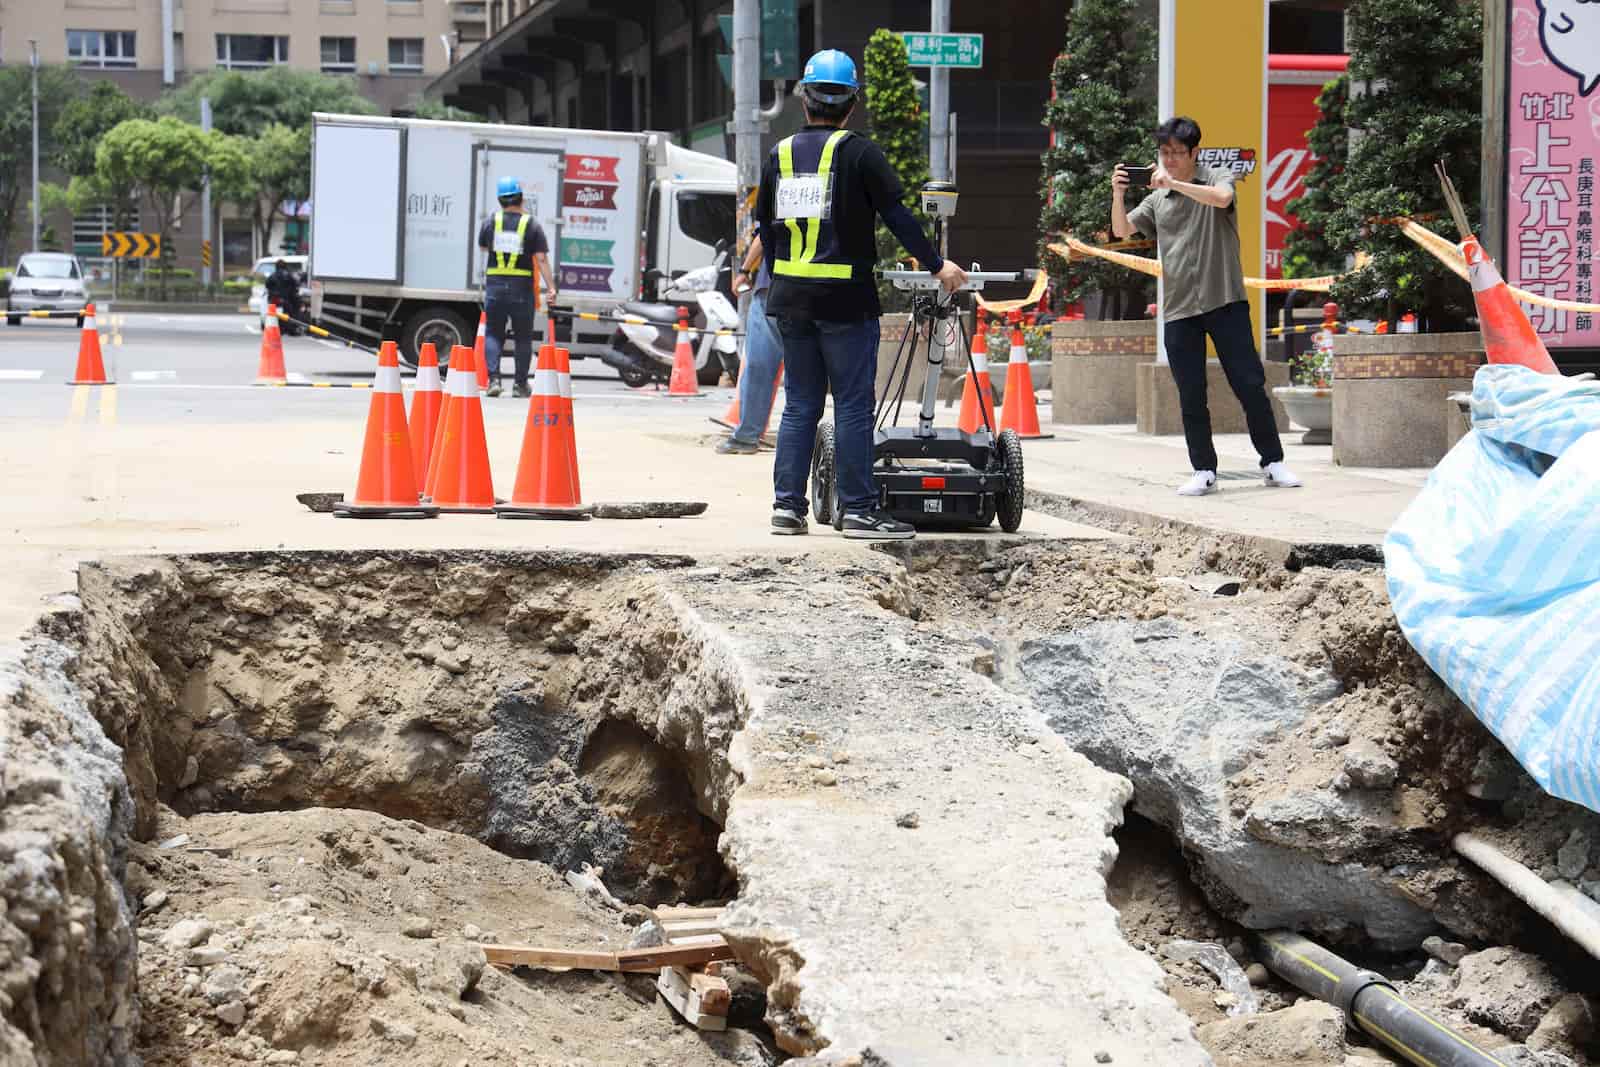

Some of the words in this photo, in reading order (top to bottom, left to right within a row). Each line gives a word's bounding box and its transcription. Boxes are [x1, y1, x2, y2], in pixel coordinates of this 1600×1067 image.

[1520, 92, 1575, 120] 竹北
[1519, 121, 1572, 334] 上允診所
